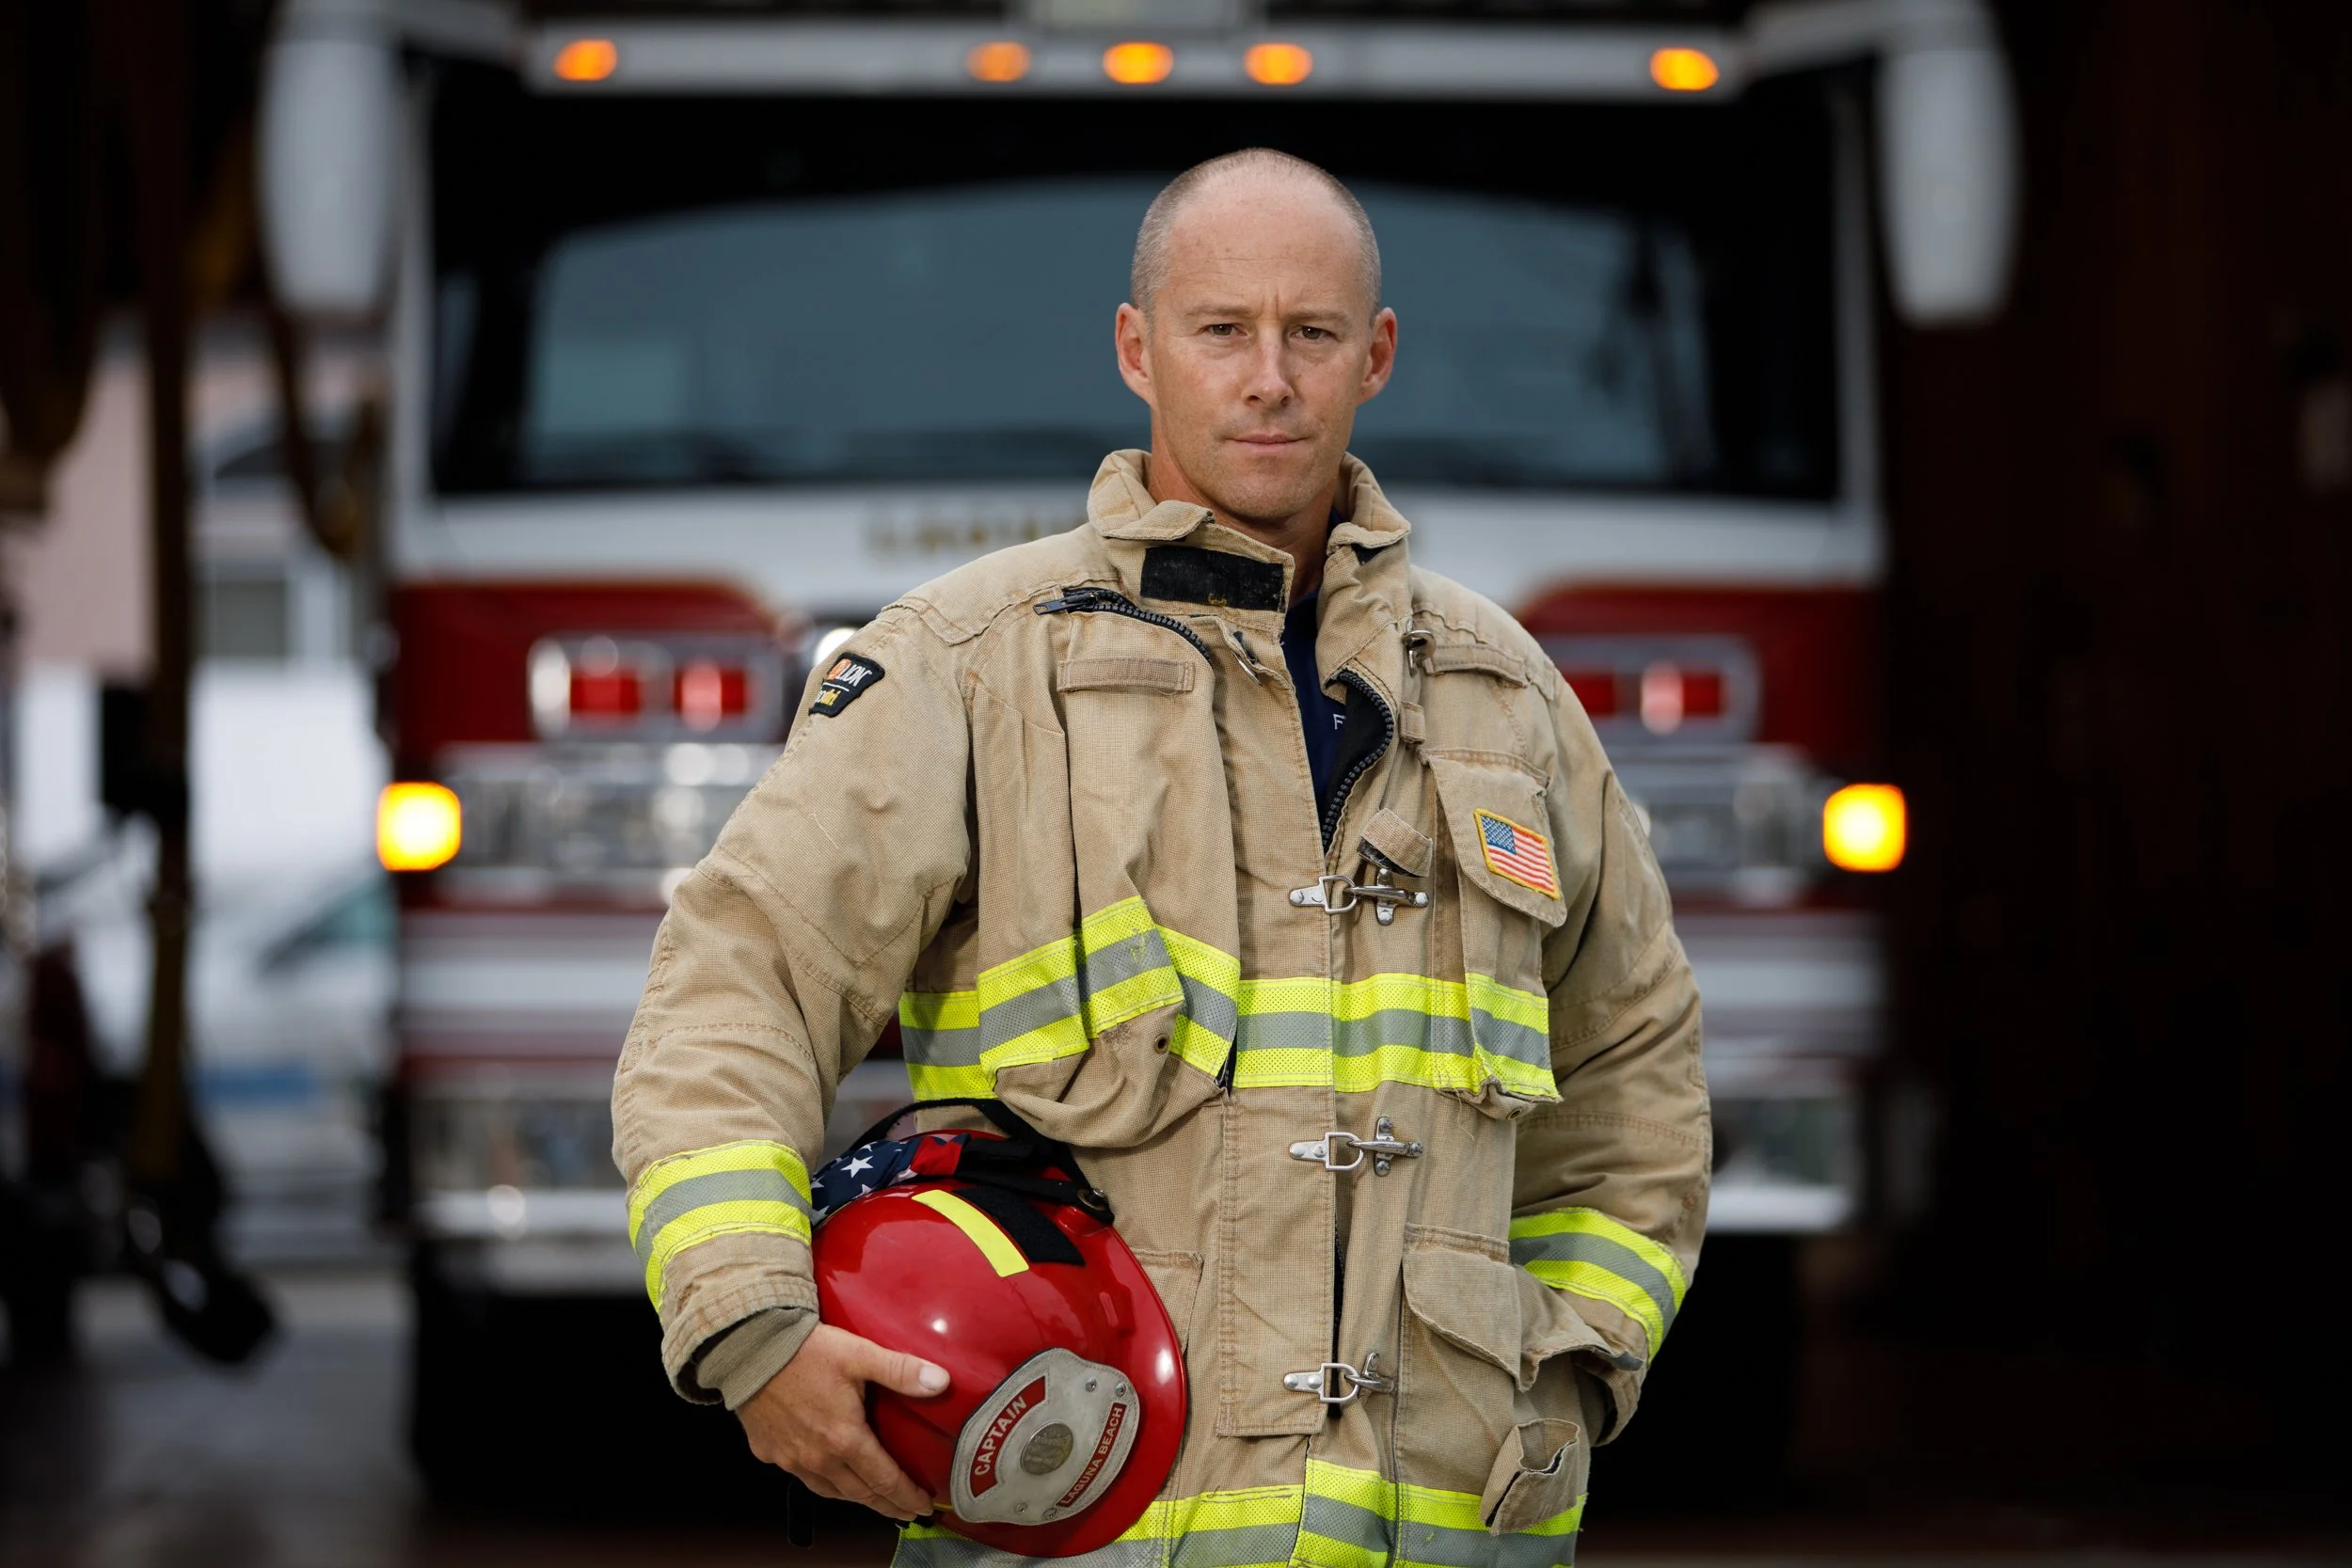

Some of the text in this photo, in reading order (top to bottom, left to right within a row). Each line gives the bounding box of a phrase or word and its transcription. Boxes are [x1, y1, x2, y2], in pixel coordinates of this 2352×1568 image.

[974, 1396, 1027, 1477] CAPTAIN
[1062, 1406, 1123, 1505] LAGUNA BEACH
